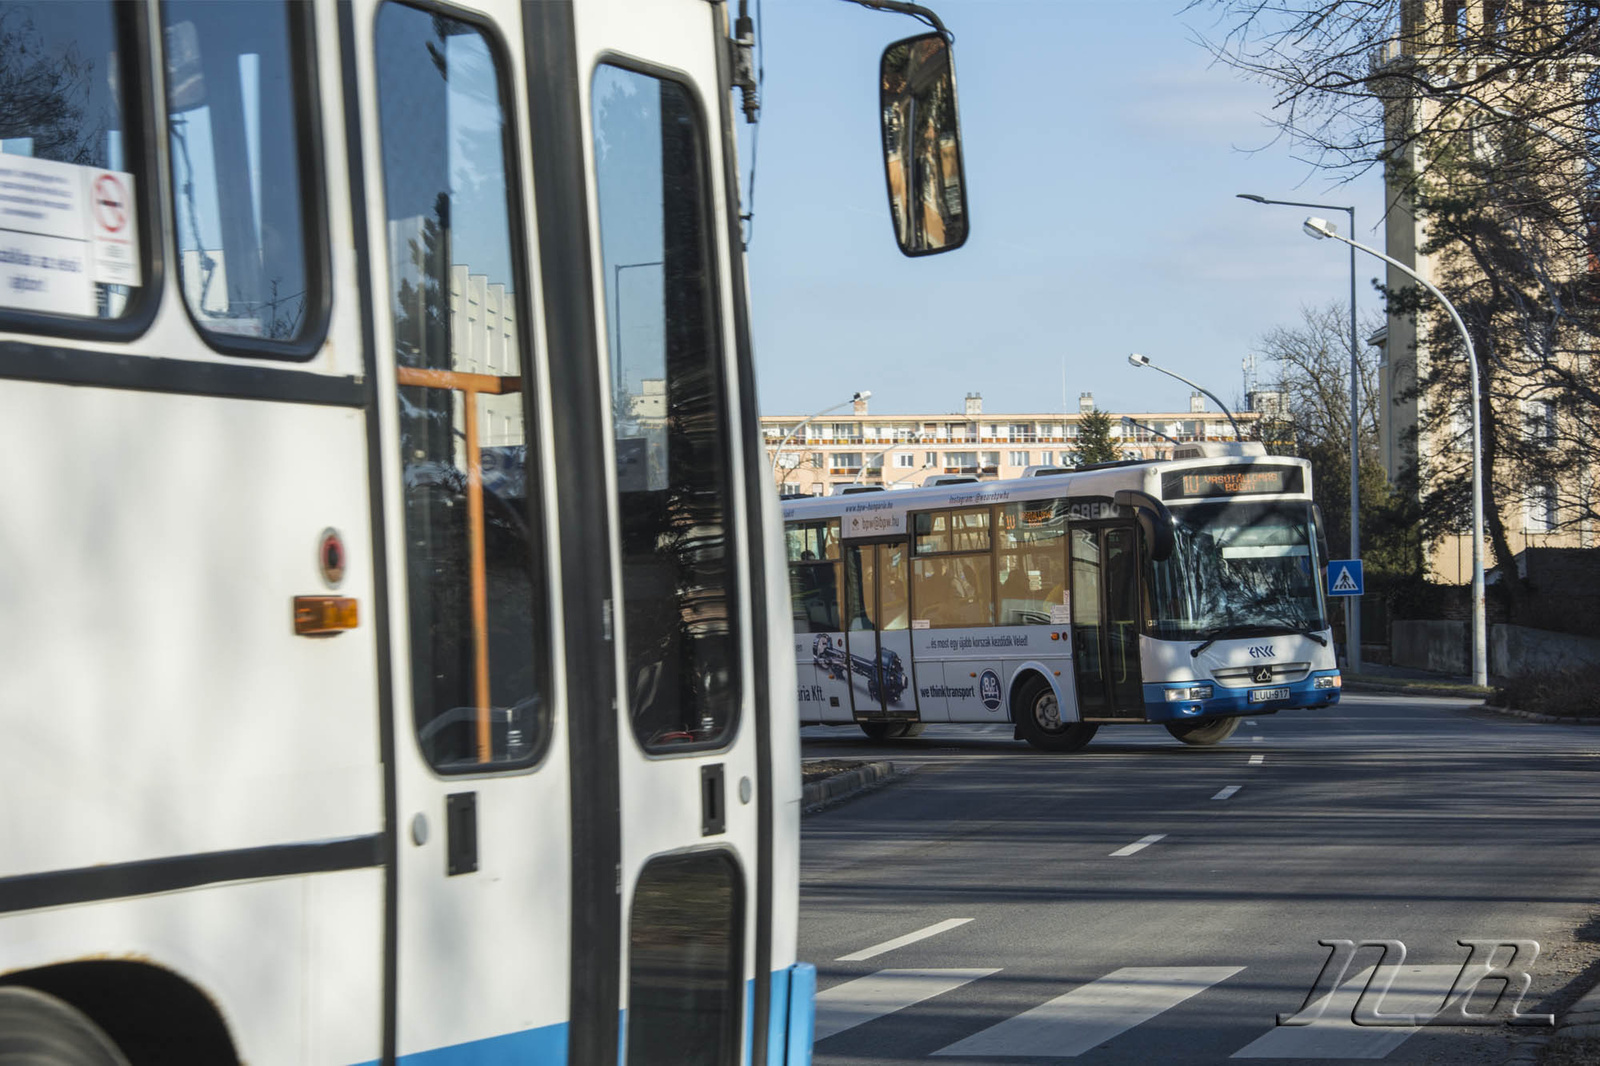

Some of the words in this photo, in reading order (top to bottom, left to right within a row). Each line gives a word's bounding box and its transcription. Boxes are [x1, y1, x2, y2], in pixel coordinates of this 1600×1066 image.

[937, 638, 949, 649] most
[950, 639, 959, 651] egy
[811, 684, 826, 701] Kft.
[920, 688, 930, 698] we
[930, 684, 945, 698] think
[946, 685, 976, 701] transport
[1253, 689, 1289, 702] LUU-917
